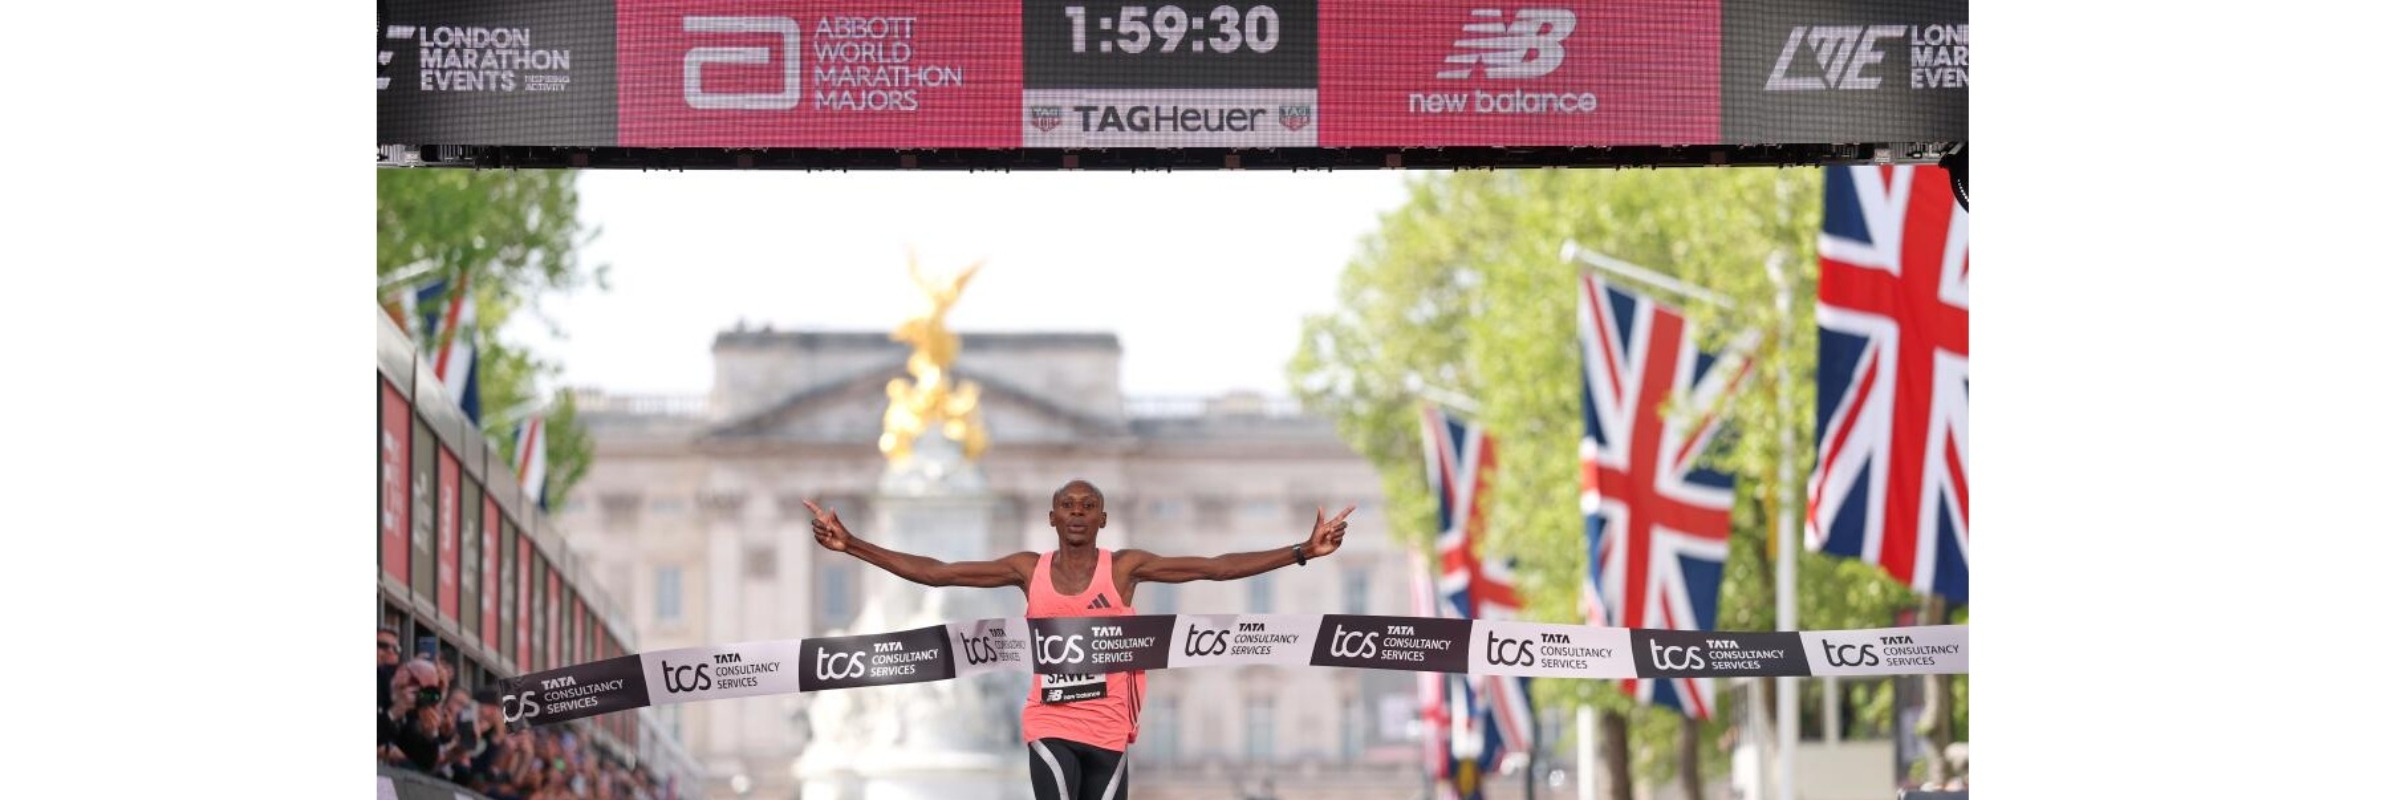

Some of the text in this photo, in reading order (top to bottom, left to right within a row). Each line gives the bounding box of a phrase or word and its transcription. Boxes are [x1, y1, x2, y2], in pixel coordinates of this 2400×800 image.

[815, 17, 917, 39] ABBOTT
[1065, 5, 1279, 53] 1:59:30
[420, 26, 530, 48] LONDON
[814, 41, 913, 63] WORLD
[420, 49, 570, 70] MARATHON
[421, 70, 516, 91] EVENTS
[815, 65, 963, 87] MARATHON
[815, 90, 918, 111] MAJORS
[1409, 89, 1597, 113] new balance
[1091, 626, 1122, 637] TATA
[1238, 623, 1265, 632] TATA
[1387, 625, 1415, 636] TATA
[1091, 637, 1155, 650] CONSULTANCY
[1184, 623, 1230, 657] tcs
[1234, 634, 1299, 645] CONSULTANCY
[1330, 624, 1379, 659] tcs
[1383, 637, 1452, 650] CONSULTANCY
[1540, 633, 1570, 644] TATA
[1705, 639, 1739, 649] TATA
[1880, 635, 1914, 645] TATA
[873, 641, 902, 653] TATA
[960, 632, 997, 665] tcs
[1034, 628, 1084, 664] tcs
[1231, 645, 1272, 655] SERVICES
[1486, 630, 1535, 667] tcs
[1540, 645, 1612, 658] CONSULTANCY
[1822, 638, 1879, 667] tcs
[1883, 644, 1959, 656] CONSULTANCY
[714, 653, 741, 664] TATA
[872, 649, 938, 664] CONSULTANCY
[1091, 651, 1133, 664] SERVICES
[1380, 649, 1425, 662] SERVICES
[1649, 639, 1705, 671] tcs
[1709, 650, 1785, 660] CONSULTANCY
[1886, 657, 1935, 667] SERVICES
[716, 662, 780, 676] CONSULTANCY
[816, 647, 866, 680] tcs
[870, 664, 915, 677] SERVICES
[1541, 658, 1587, 669] SERVICES
[1711, 660, 1761, 670] SERVICES
[541, 676, 576, 690] TATA
[662, 661, 711, 694] tcs
[717, 677, 758, 690] SERVICES
[544, 679, 623, 701] CONSULTANCY
[503, 691, 540, 722] cs
[547, 696, 598, 714] SERVICES
